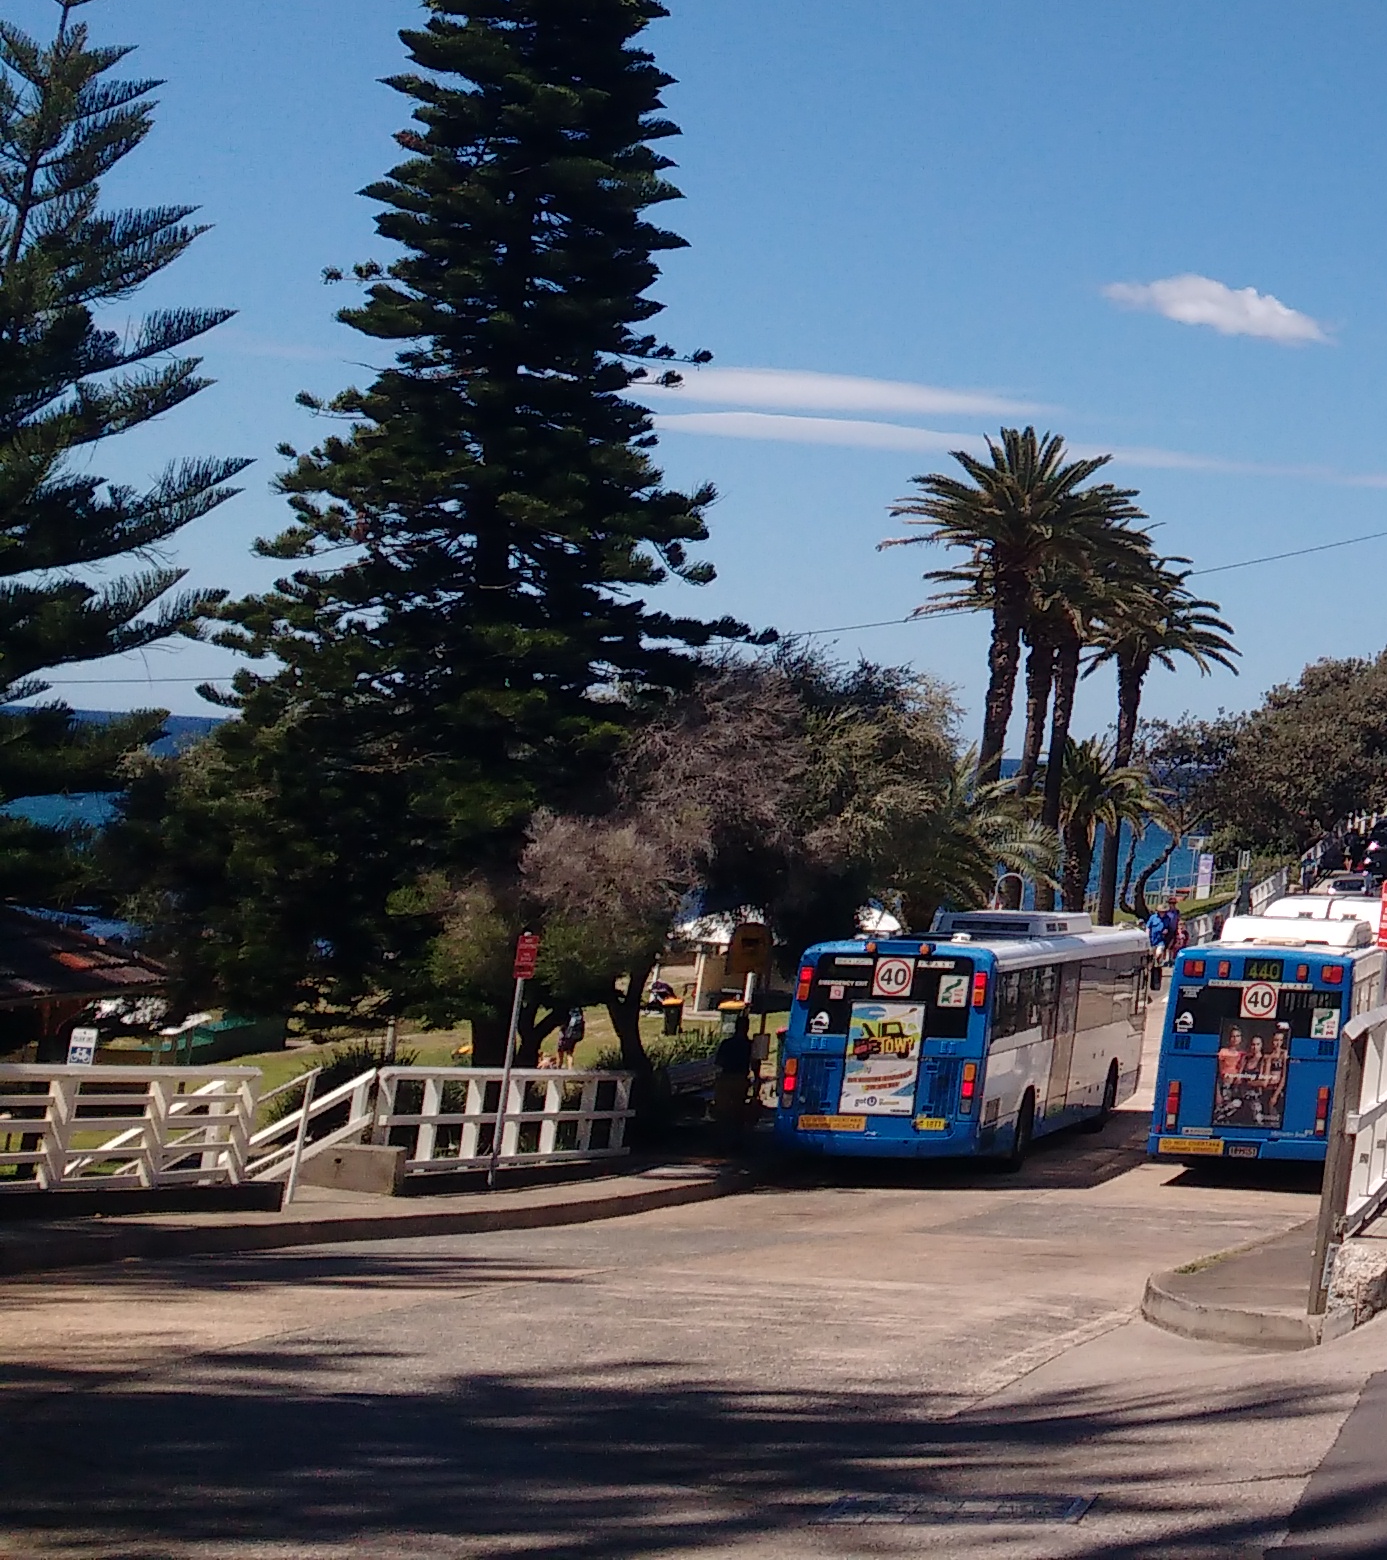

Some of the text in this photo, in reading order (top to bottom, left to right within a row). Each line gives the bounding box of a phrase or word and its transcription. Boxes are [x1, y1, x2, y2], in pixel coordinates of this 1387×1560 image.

[880, 968, 907, 985] 40
[1248, 963, 1281, 980] 440
[1248, 991, 1273, 1008] 40
